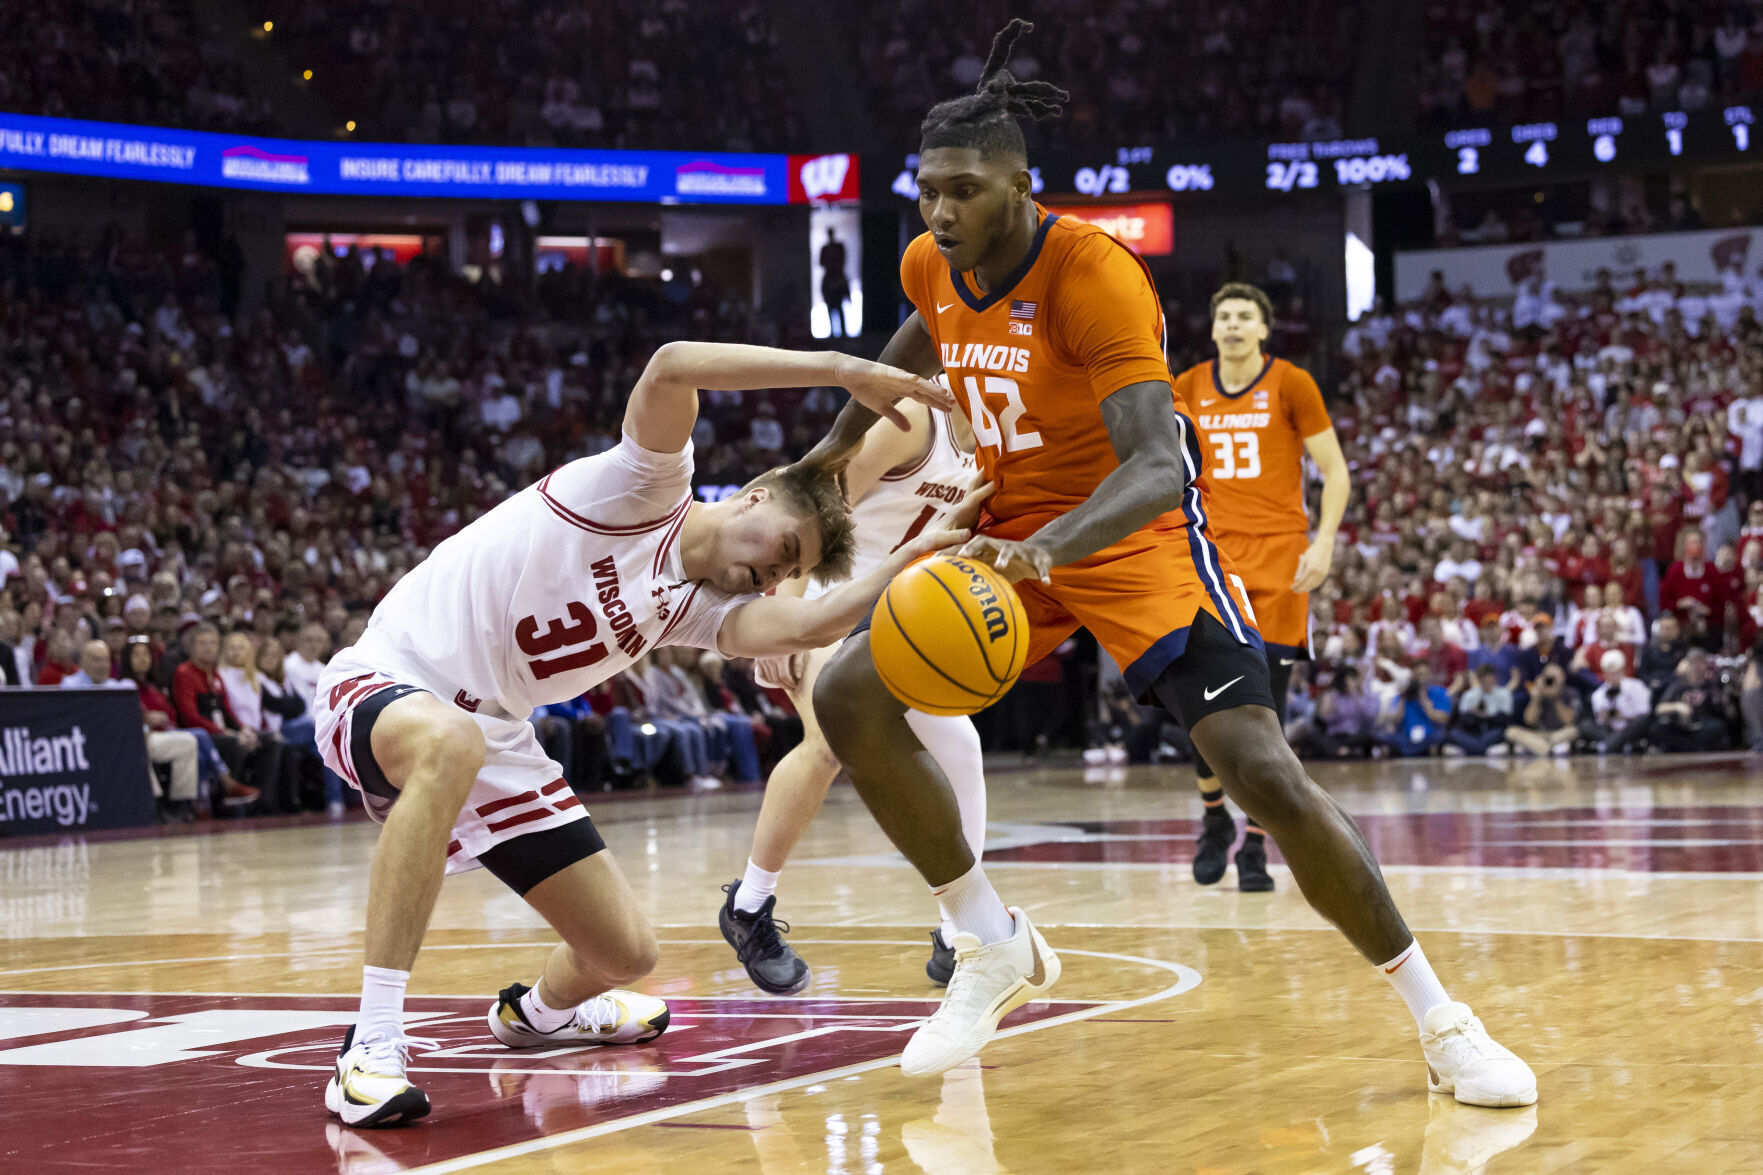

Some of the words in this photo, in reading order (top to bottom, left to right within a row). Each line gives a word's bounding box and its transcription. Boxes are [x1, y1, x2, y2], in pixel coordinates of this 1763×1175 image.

[1666, 128, 1682, 156] 1
[1732, 123, 1749, 151] 1
[1457, 147, 1480, 174] 2
[1525, 139, 1549, 167] 4
[339, 157, 400, 181] INSURE
[495, 161, 551, 186] DREAM
[555, 163, 649, 188] FEARLESSLY
[1074, 165, 1130, 197] 0/2
[1166, 164, 1214, 191] 0%
[1265, 160, 1319, 191] 2/2
[1334, 153, 1411, 185] 100%
[941, 343, 1030, 373] ILLINOIS
[963, 376, 1044, 456] 42
[1199, 413, 1271, 430] ILLINOIS
[1209, 431, 1261, 479] 33
[944, 557, 1009, 643] Wilson
[515, 601, 609, 681] 31
